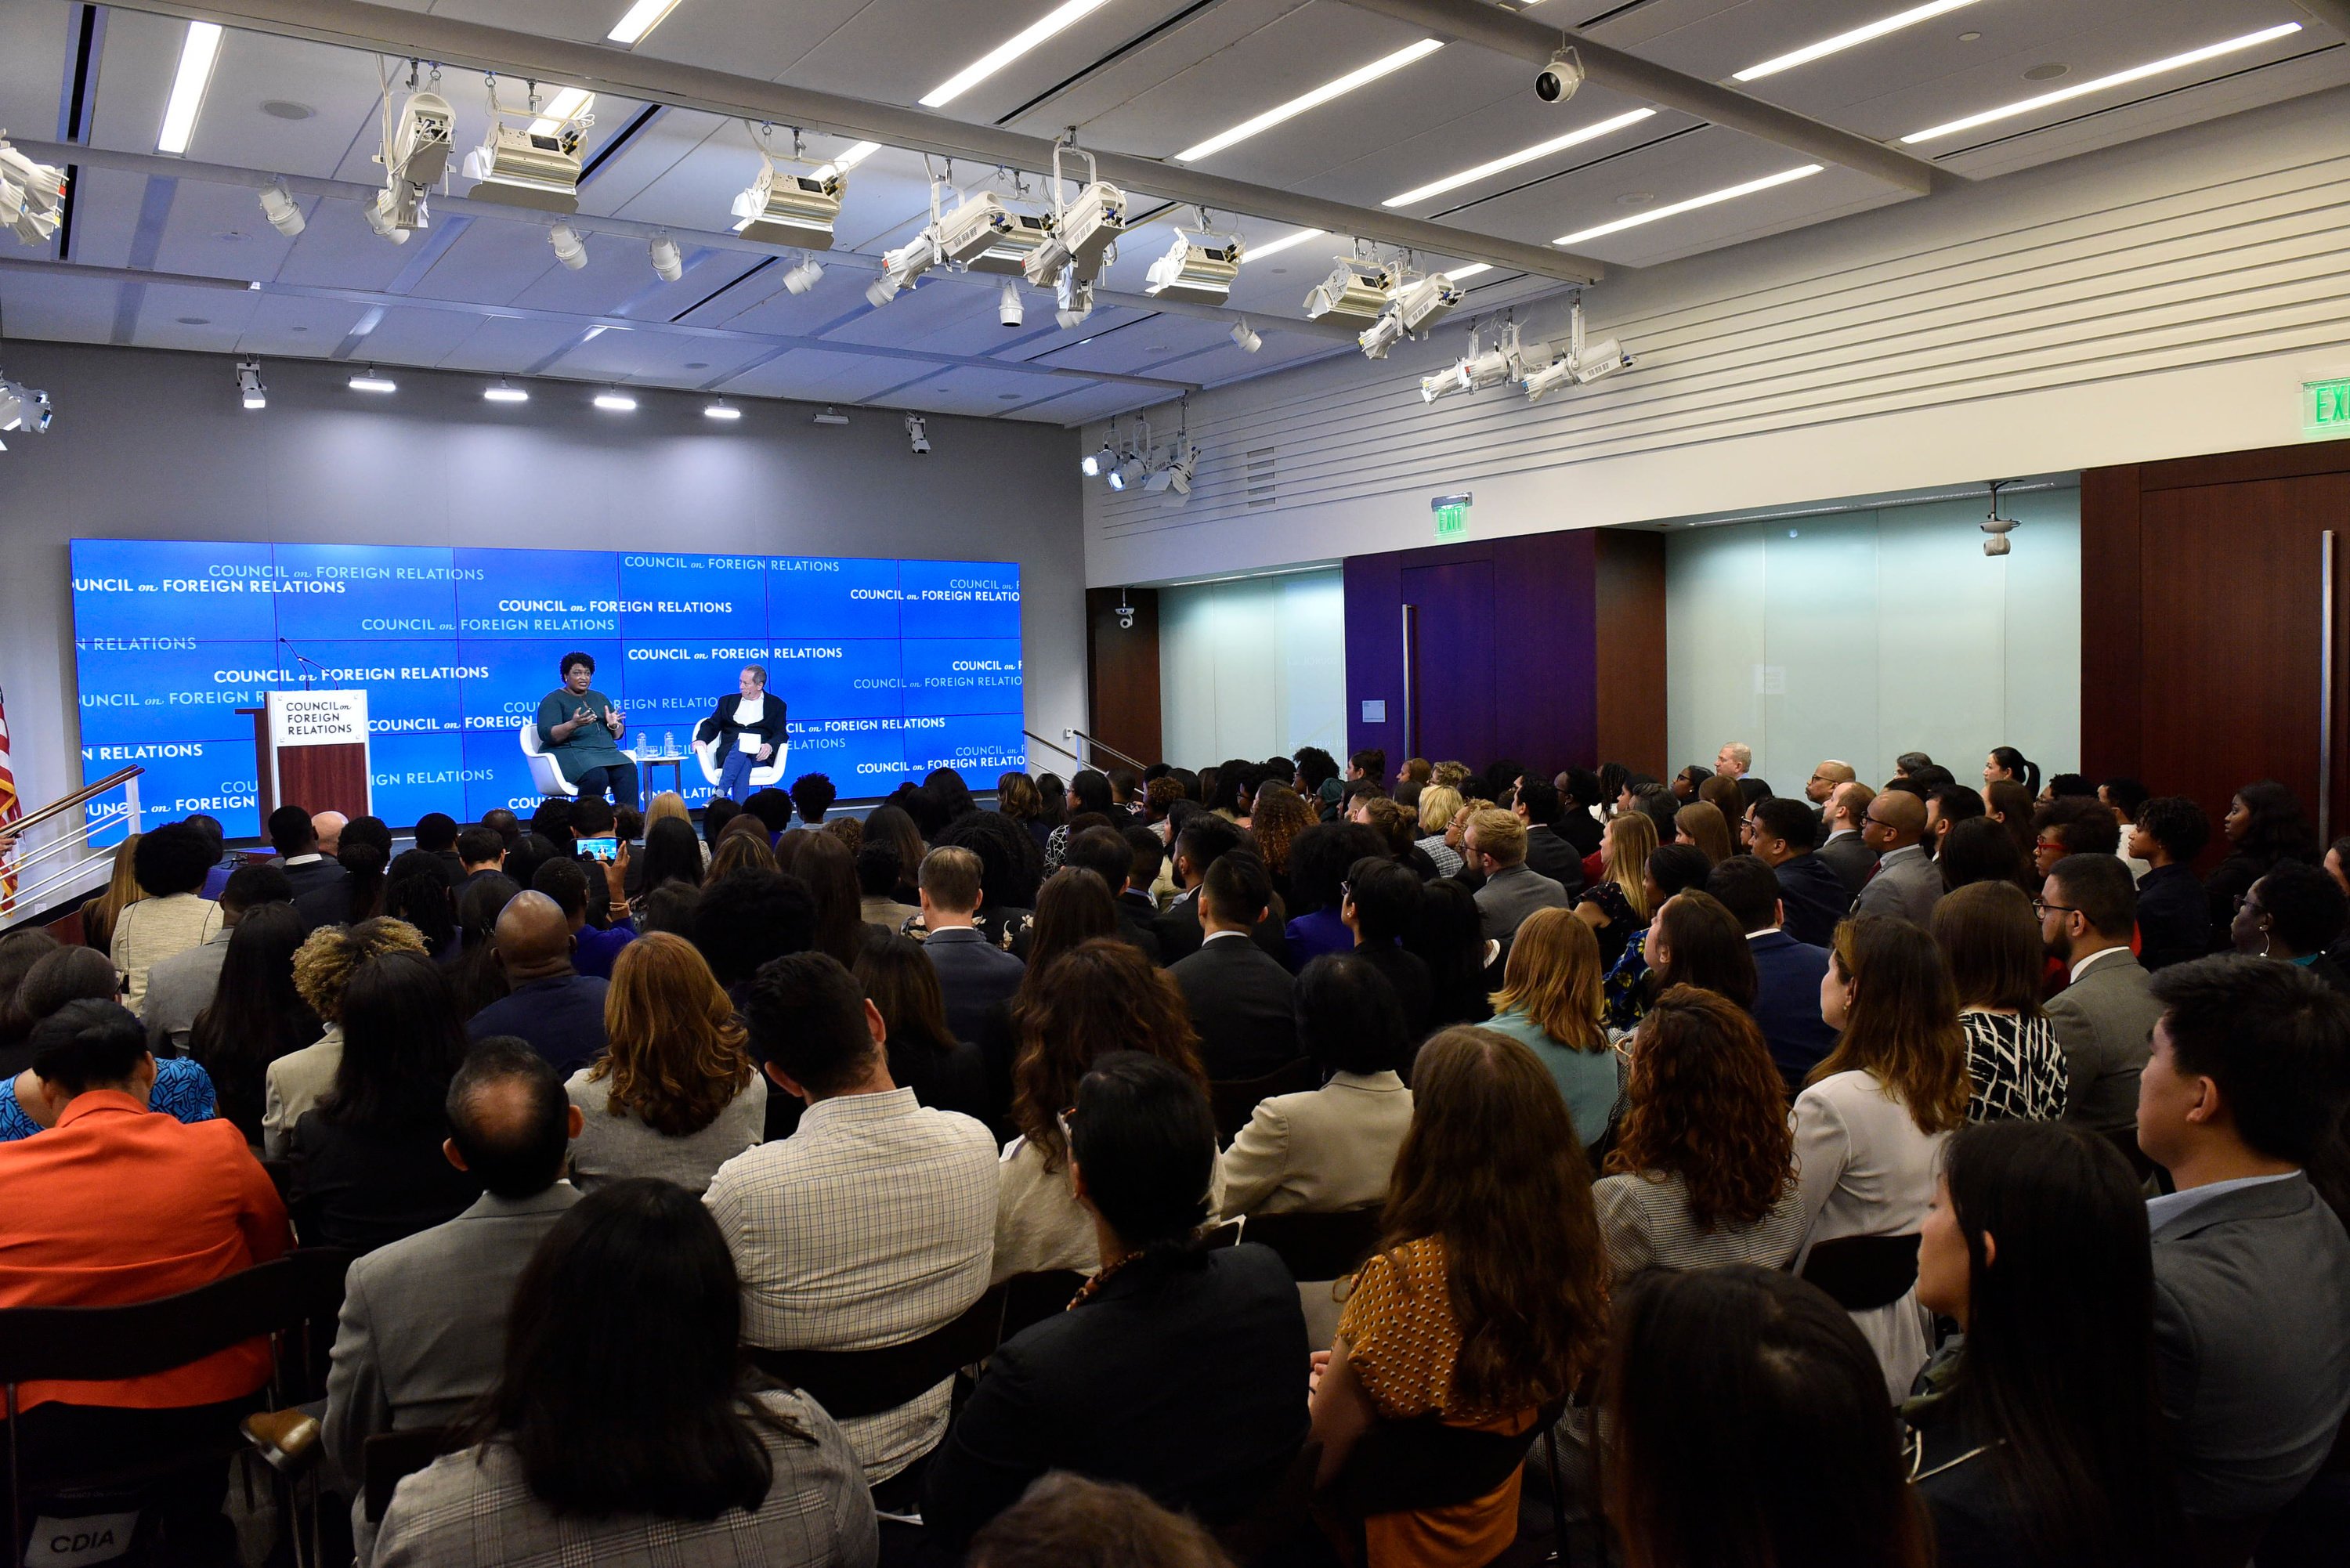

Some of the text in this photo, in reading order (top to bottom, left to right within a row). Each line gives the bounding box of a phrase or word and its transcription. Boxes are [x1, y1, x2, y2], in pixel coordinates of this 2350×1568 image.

[1438, 508, 1462, 532] EXIT
[625, 557, 687, 568] COUNCIL
[709, 558, 765, 569] FOREIGN
[772, 560, 839, 571] RELATIONS
[209, 565, 289, 577] COUNCIL
[316, 567, 389, 578] FOREIGN
[397, 568, 483, 580] RELATIONS
[71, 578, 133, 591] UNCIL
[164, 580, 243, 592] FOREIGN
[250, 580, 345, 593] RELATIONS
[950, 580, 999, 589] COUNCIL
[851, 589, 904, 600] COUNCIL
[922, 591, 971, 601] FOREIGN
[499, 600, 567, 612] COUNCIL
[590, 601, 653, 612] FOREIGN
[658, 602, 732, 612] RELATIONS
[362, 619, 435, 630] COUNCIL
[461, 620, 528, 630] FOREIGN
[534, 620, 614, 630] RELATIONS
[94, 637, 197, 651] RELATIONS
[628, 649, 690, 659] COUNCIL
[712, 649, 768, 659] FOREIGN
[775, 648, 842, 658] RELATIONS
[953, 661, 1002, 670] COUNCIL
[214, 670, 295, 683] COUNCIL
[322, 668, 395, 681] FOREIGN
[401, 667, 489, 679] RELATIONS
[854, 678, 906, 688] COUNCIL
[925, 677, 973, 687] FOREIGN
[79, 693, 139, 707] UNCIL
[169, 692, 248, 704] FOREIGN
[287, 702, 338, 711] COUNCIL
[287, 714, 339, 723] FOREIGN
[368, 718, 439, 732] COUNCIL
[465, 716, 533, 728] FOREIGN
[825, 721, 877, 732] FOREIGN
[882, 717, 945, 729] RELATIONS
[288, 724, 352, 735] RELATIONS
[100, 744, 202, 760] RELATIONS
[956, 746, 1004, 756] COUNCIL
[857, 762, 909, 773] COUNCIL
[927, 758, 977, 771] FOREIGN
[407, 769, 493, 783] RELATIONS
[176, 796, 255, 811] FOREIGN
[50, 1530, 114, 1553] CDIA
